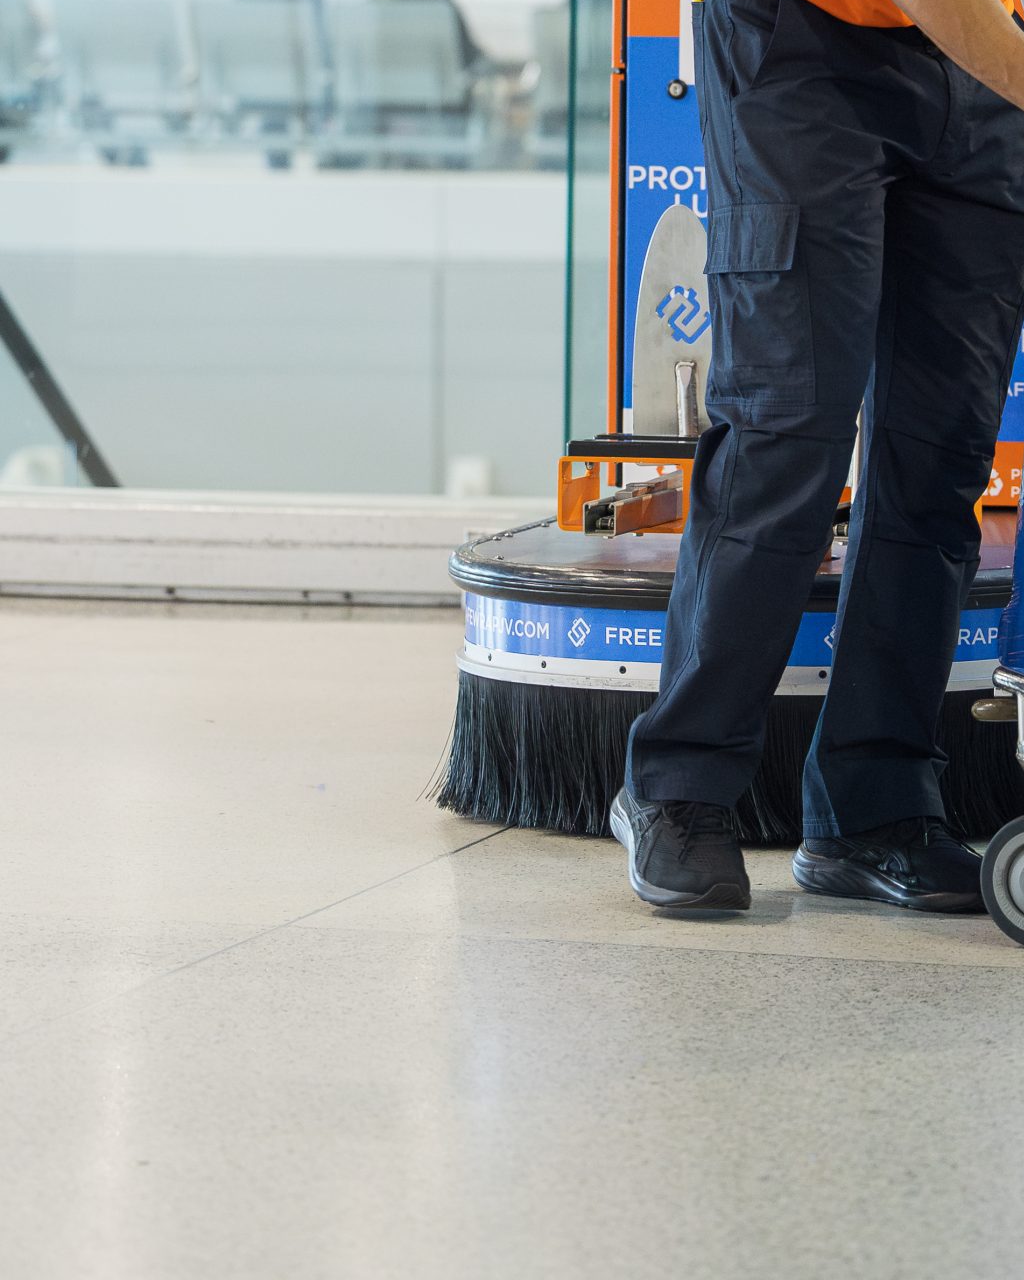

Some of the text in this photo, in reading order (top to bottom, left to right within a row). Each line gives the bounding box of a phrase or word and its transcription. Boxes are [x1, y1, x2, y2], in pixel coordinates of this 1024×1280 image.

[628, 165, 707, 191] PROT
[605, 626, 663, 647] FREE
[957, 626, 999, 646] RAP
